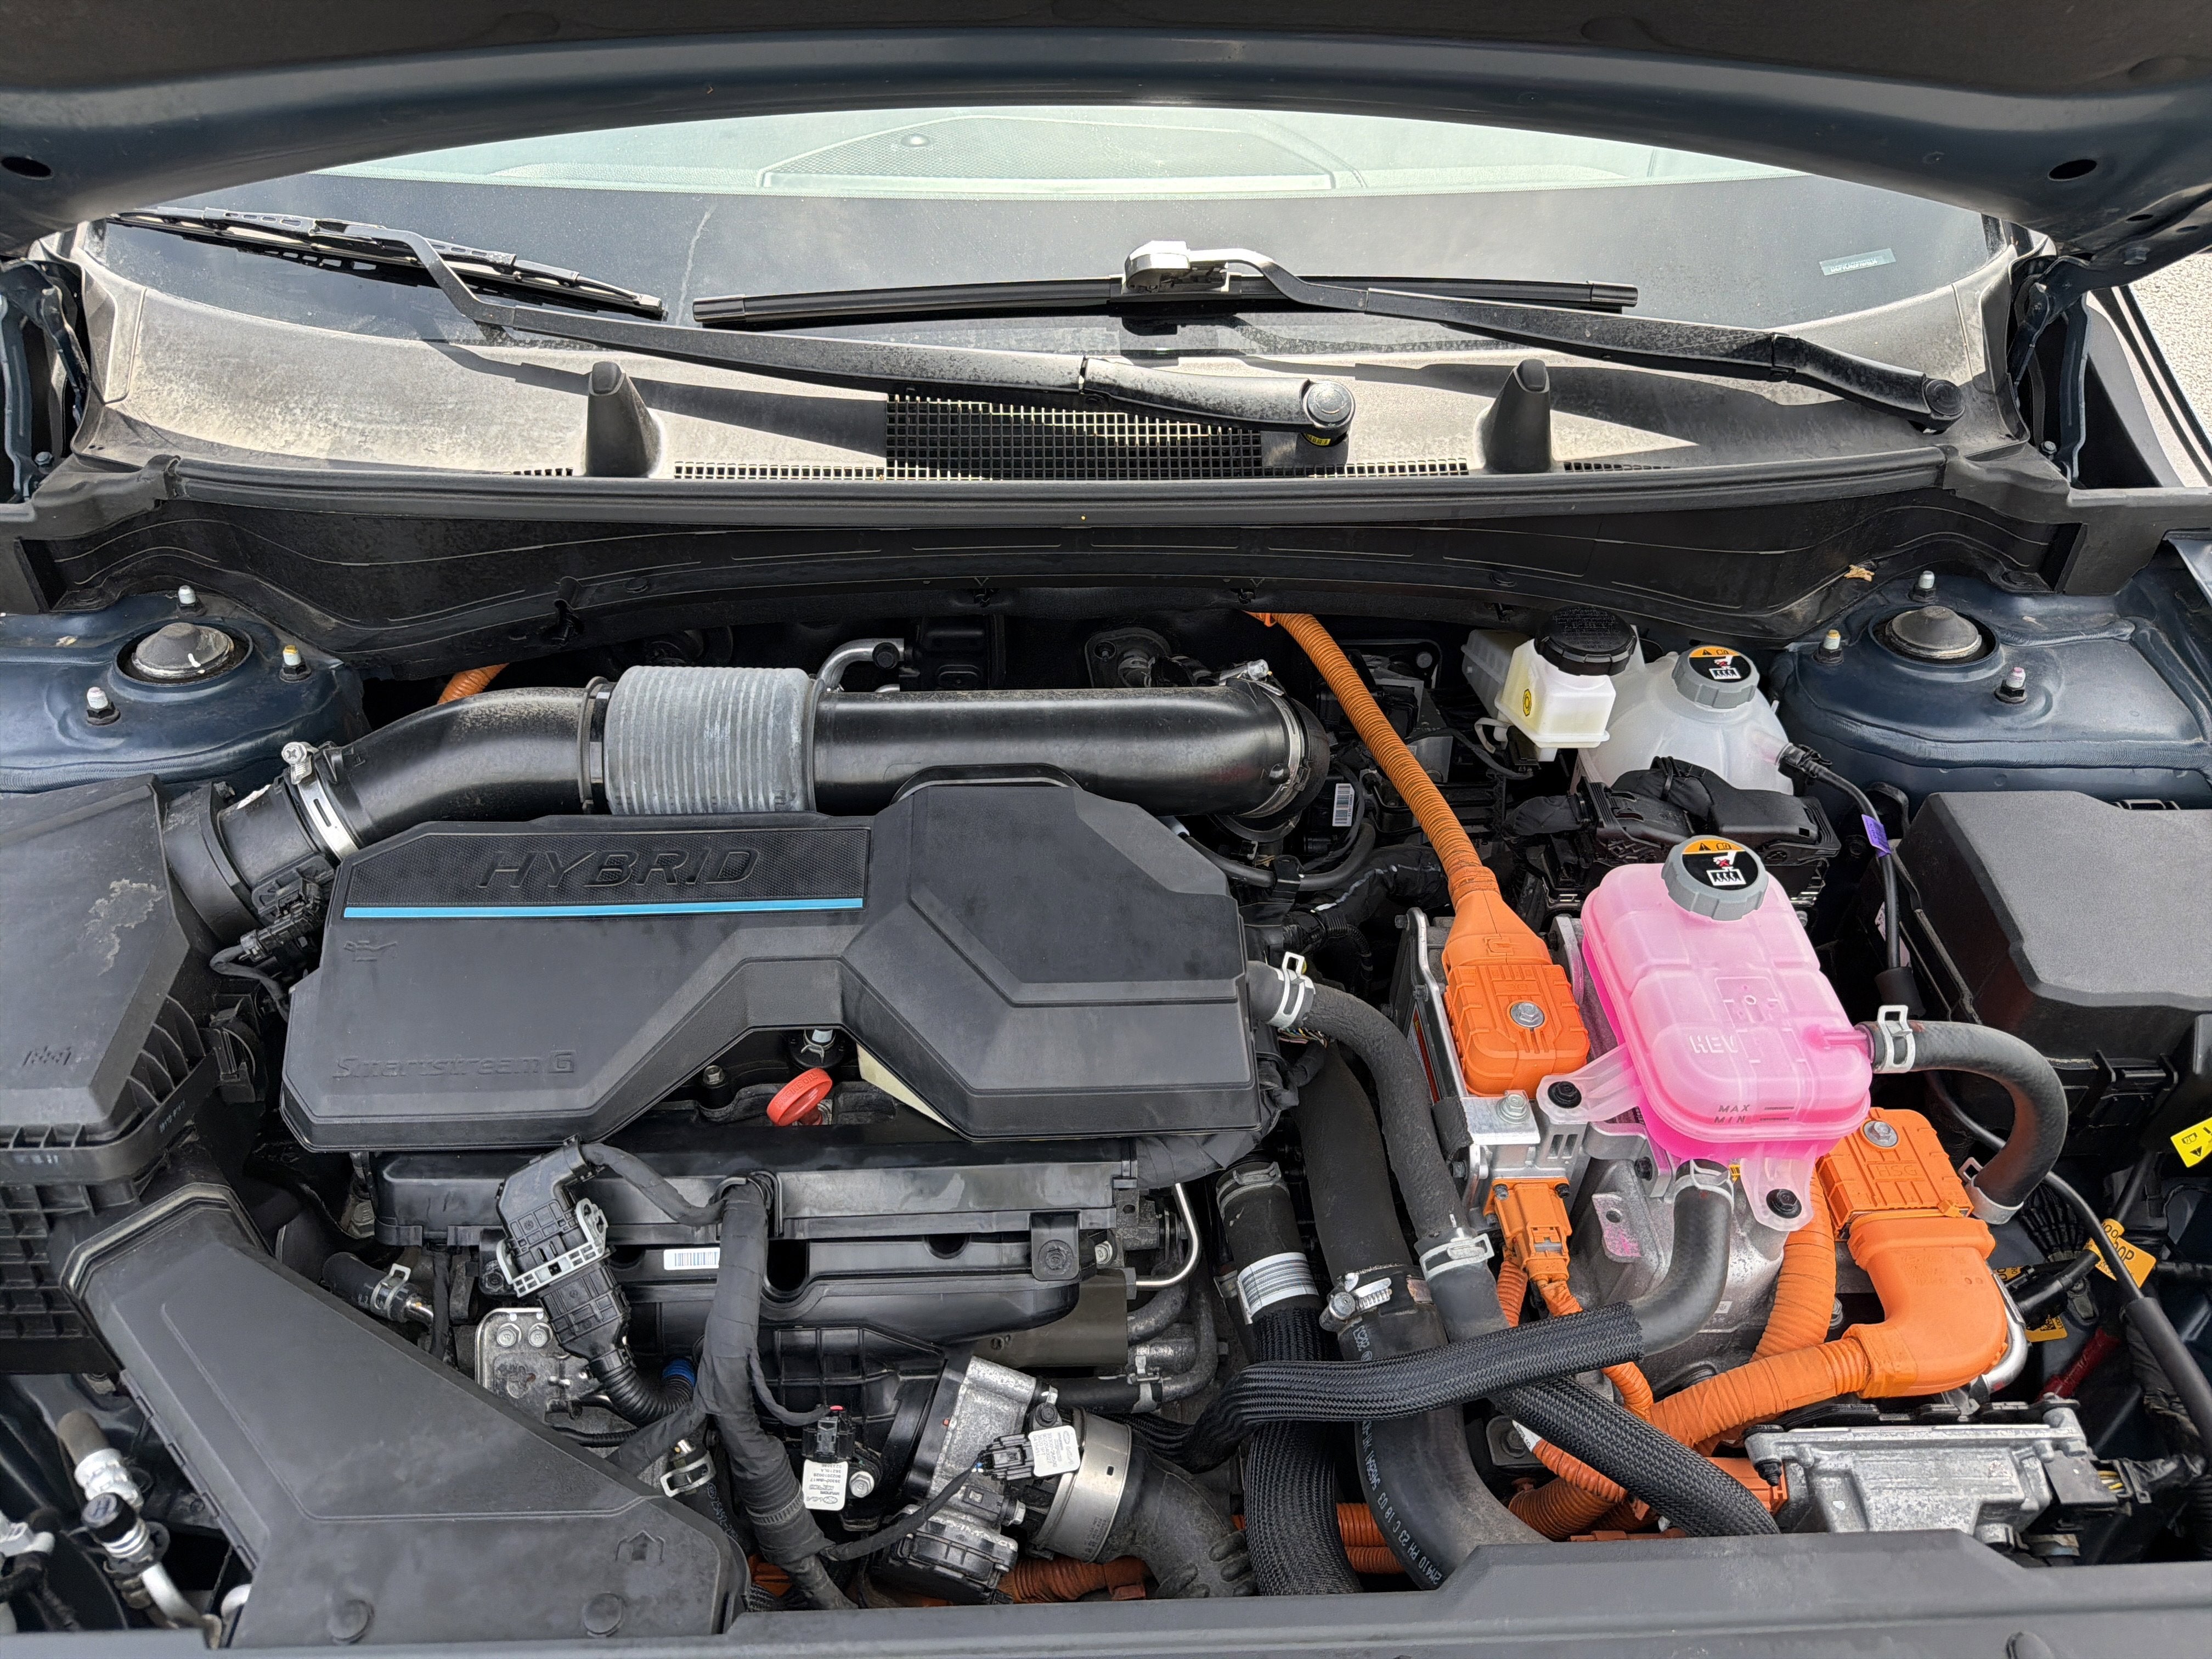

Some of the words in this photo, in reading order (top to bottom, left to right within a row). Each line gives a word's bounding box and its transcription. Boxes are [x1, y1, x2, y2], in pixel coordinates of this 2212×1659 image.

[476, 848, 760, 888] HYBRID
[1689, 1034, 1739, 1053] HEV
[1718, 1104, 1751, 1113] MAX
[1714, 1115, 1746, 1124] MIN
[1876, 1164, 1918, 1177] HSG
[1376, 1492, 1389, 1510] 03
[1384, 1506, 1396, 1523] 18
[1398, 1529, 1410, 1547] 23
[1407, 1542, 1421, 1561] PH
